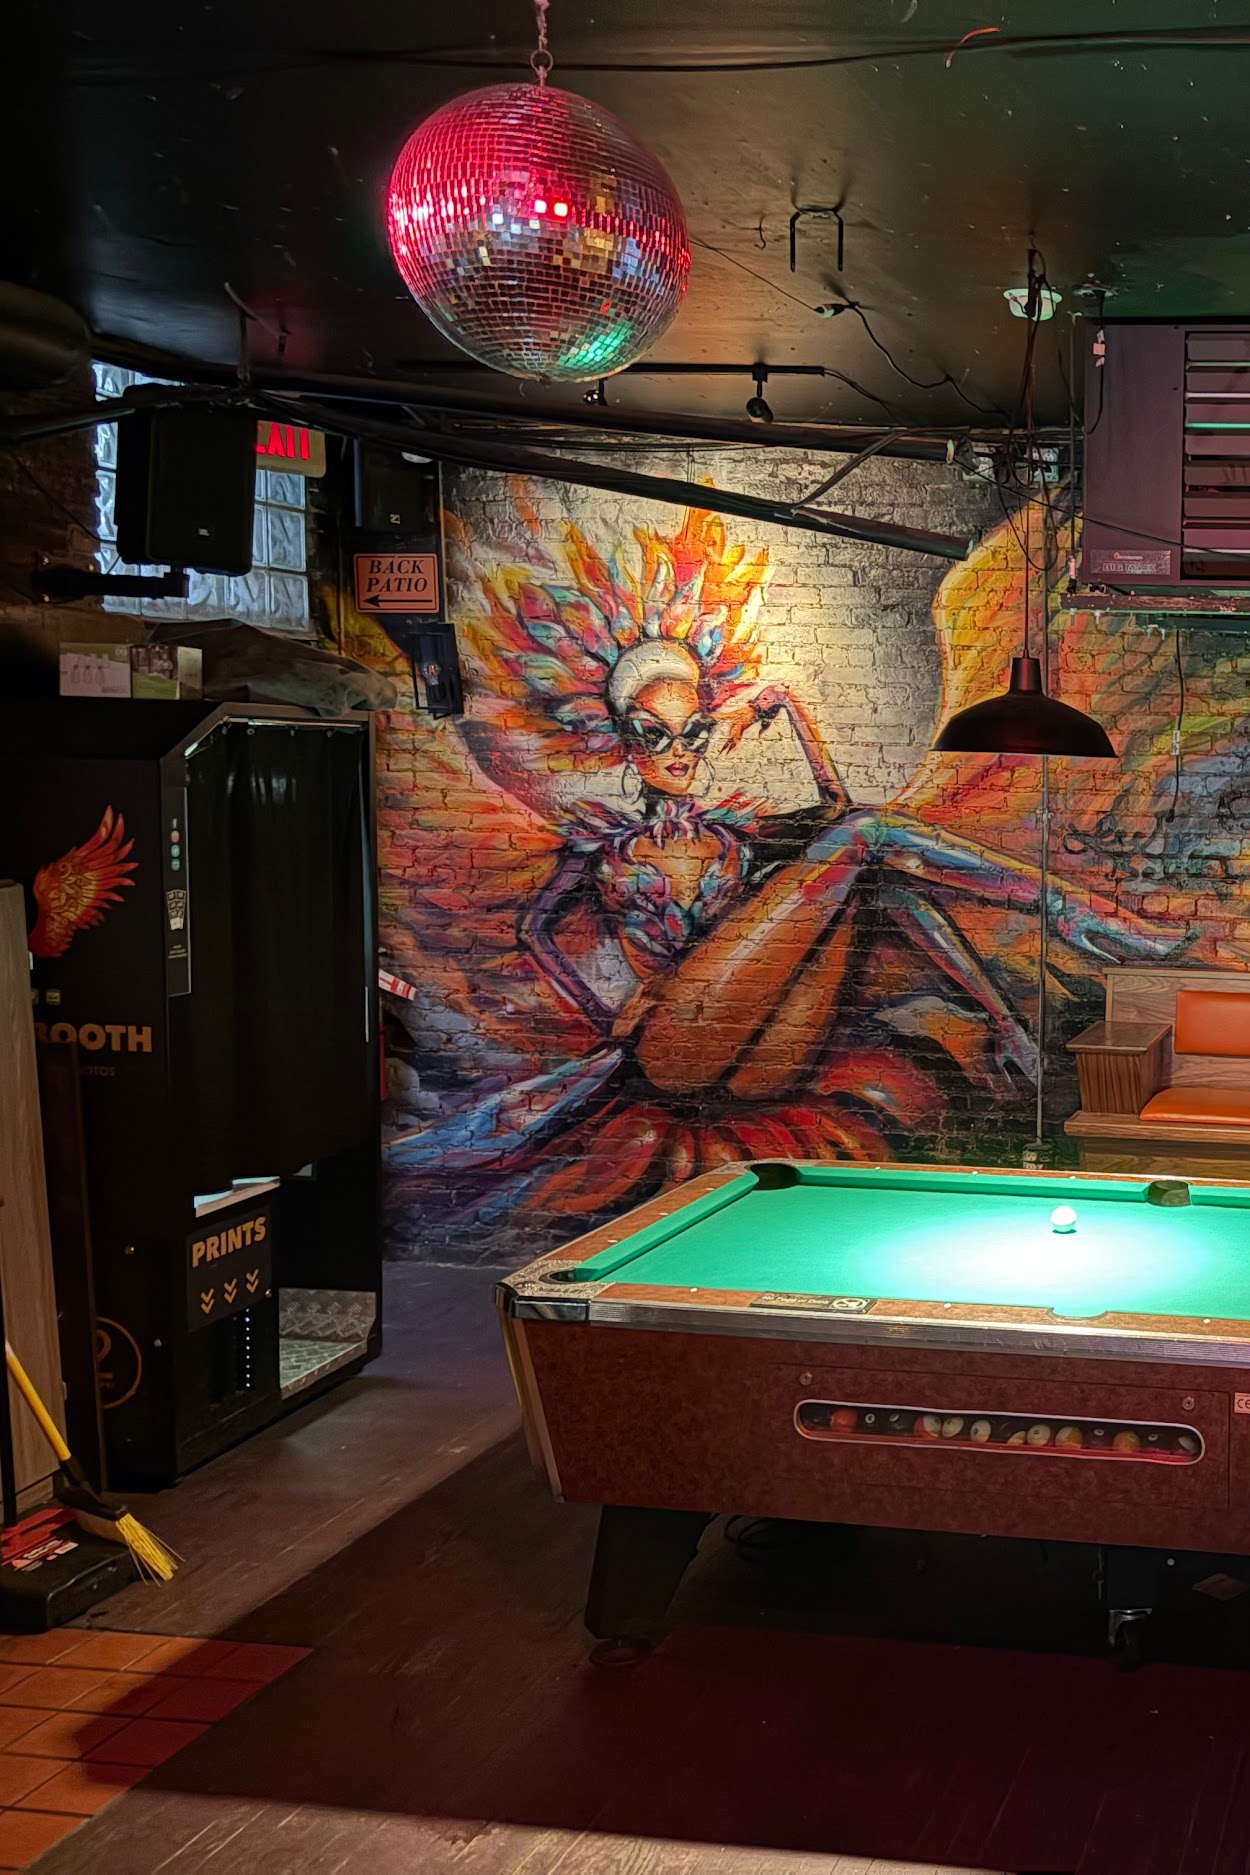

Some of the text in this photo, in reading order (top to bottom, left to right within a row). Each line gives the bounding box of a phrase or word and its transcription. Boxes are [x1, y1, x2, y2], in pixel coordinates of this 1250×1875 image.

[369, 559, 425, 574] BACK
[366, 577, 428, 593] PATIO
[192, 1216, 266, 1268] PRINTS
